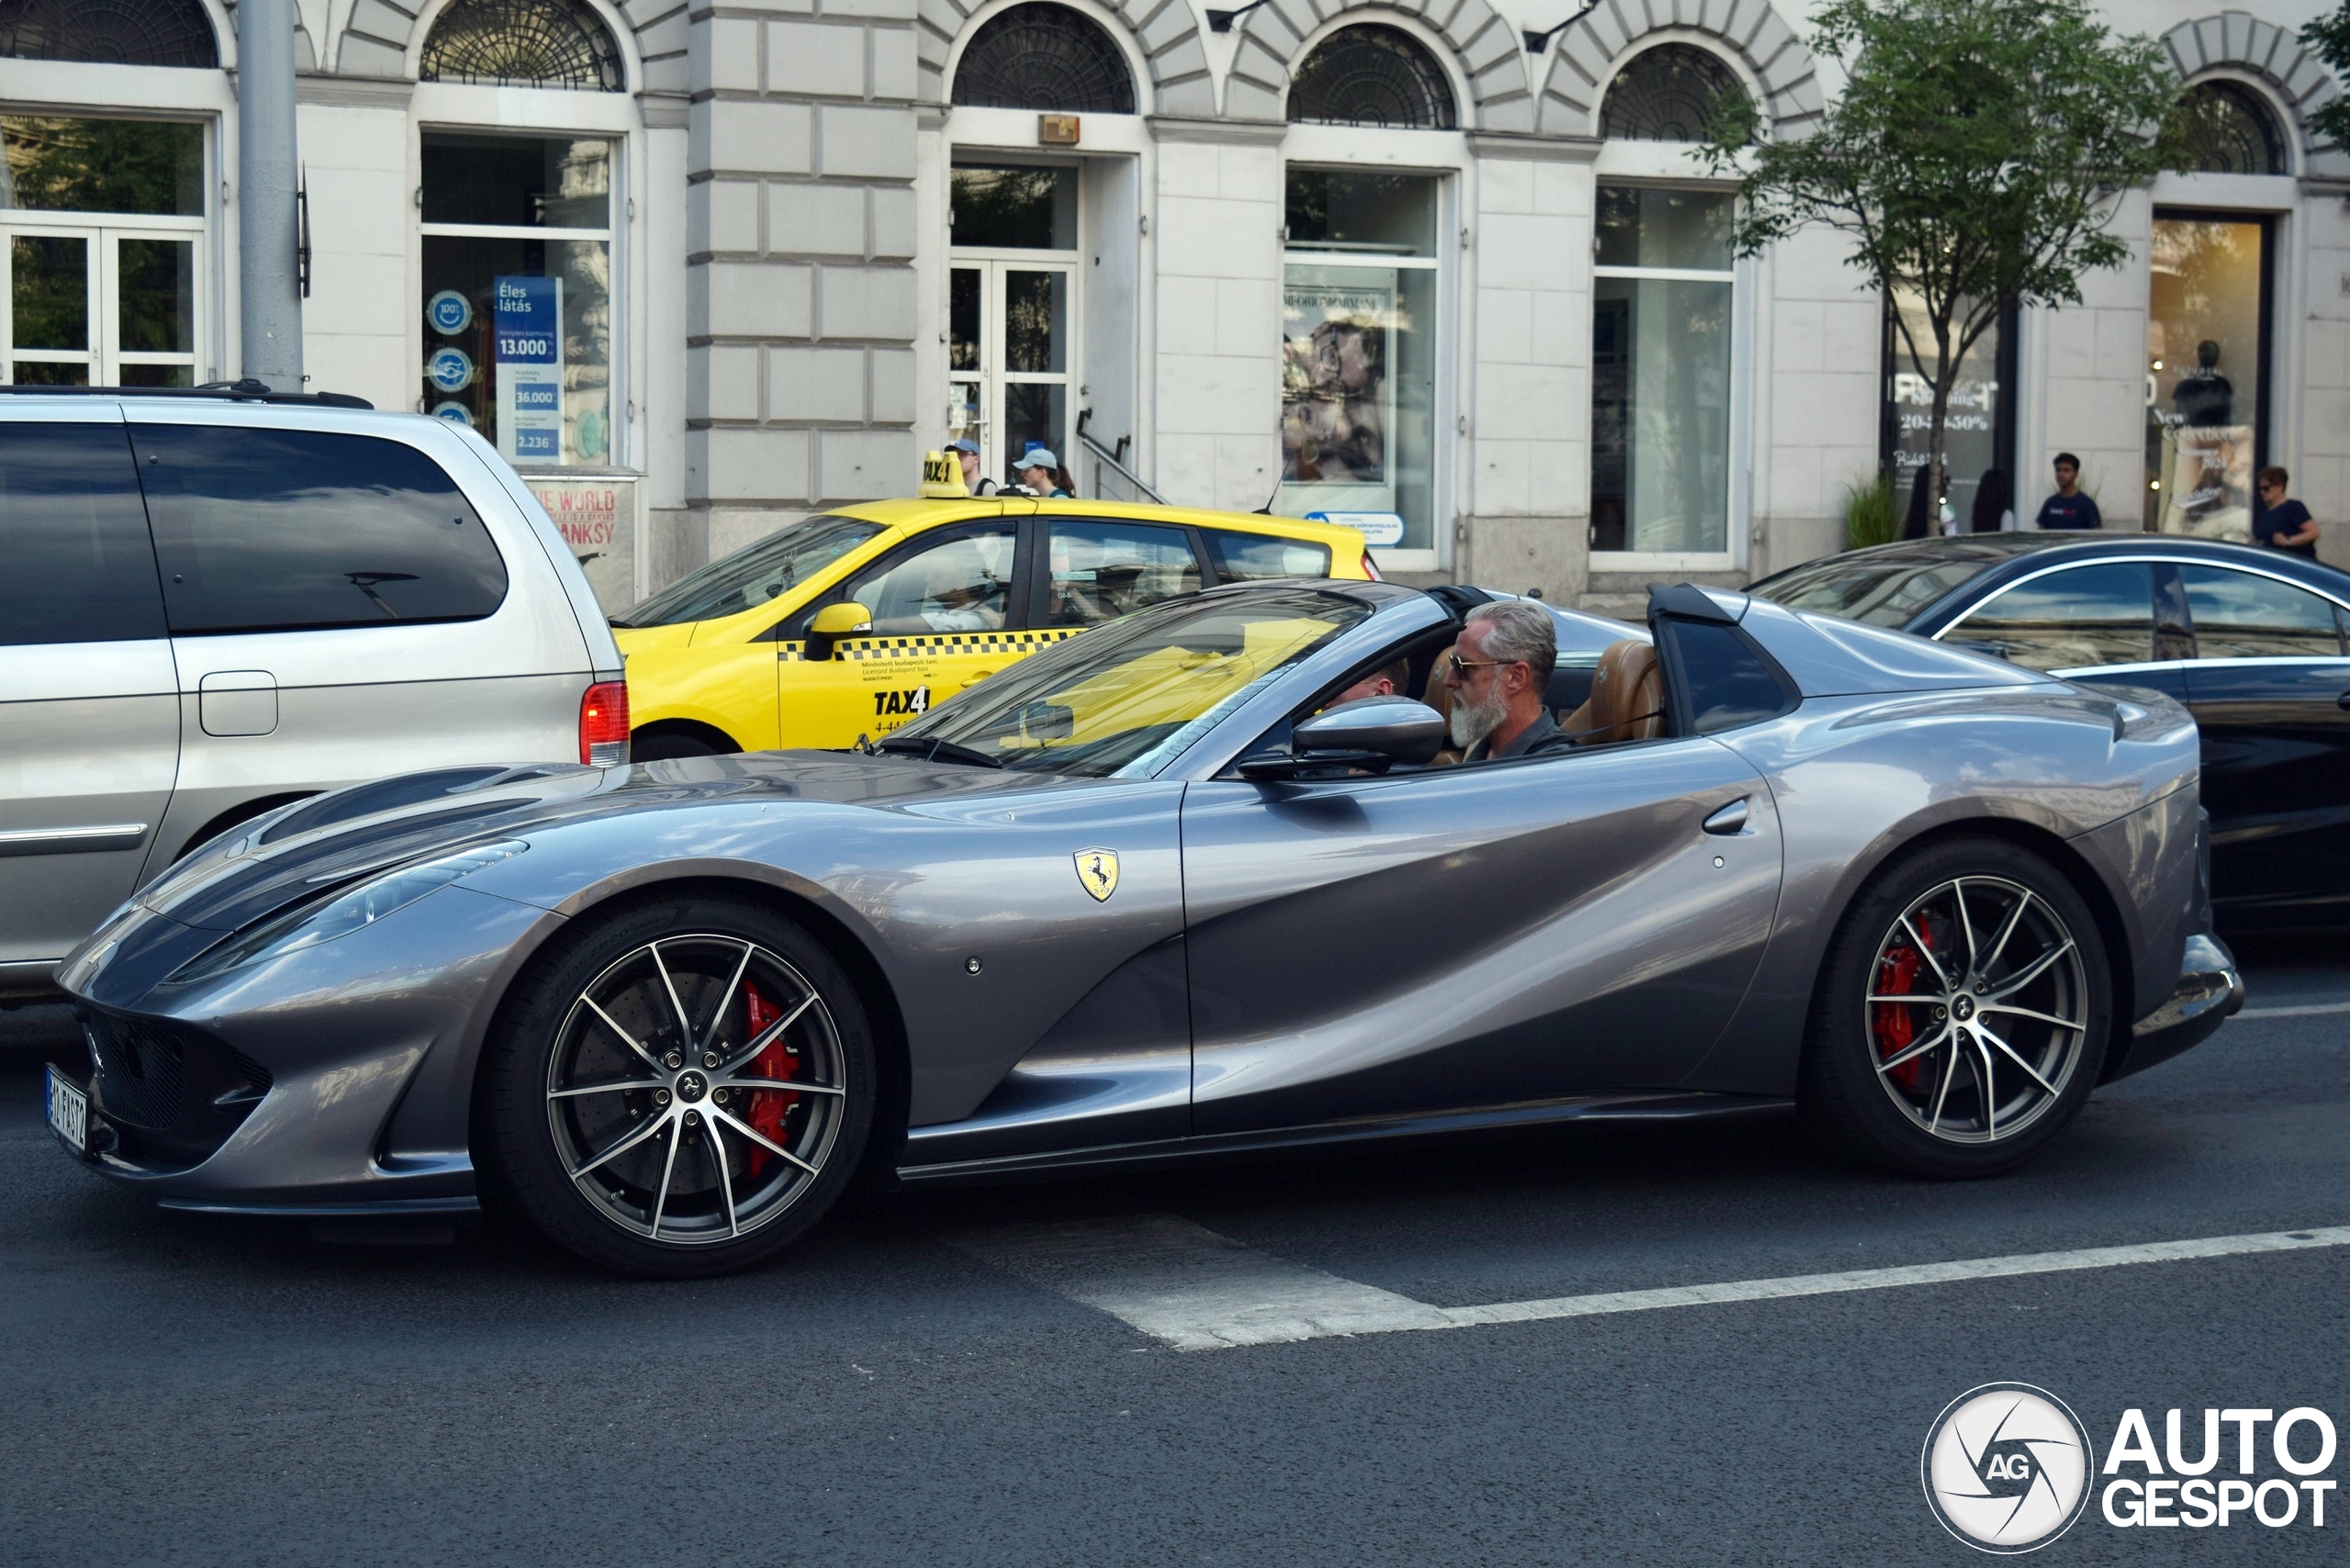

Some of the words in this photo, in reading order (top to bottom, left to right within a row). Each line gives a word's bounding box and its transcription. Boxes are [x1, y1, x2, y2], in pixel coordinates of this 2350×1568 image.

[499, 282, 527, 297] Éles
[499, 298, 532, 312] látás
[1283, 296, 1321, 307] MPORIO
[500, 339, 547, 356] 13.000
[516, 391, 553, 404] 36.000
[518, 437, 549, 448] 2.236
[560, 490, 615, 511] WORLD
[560, 523, 615, 545] ANKSY
[590, 929, 628, 958] ZR20
